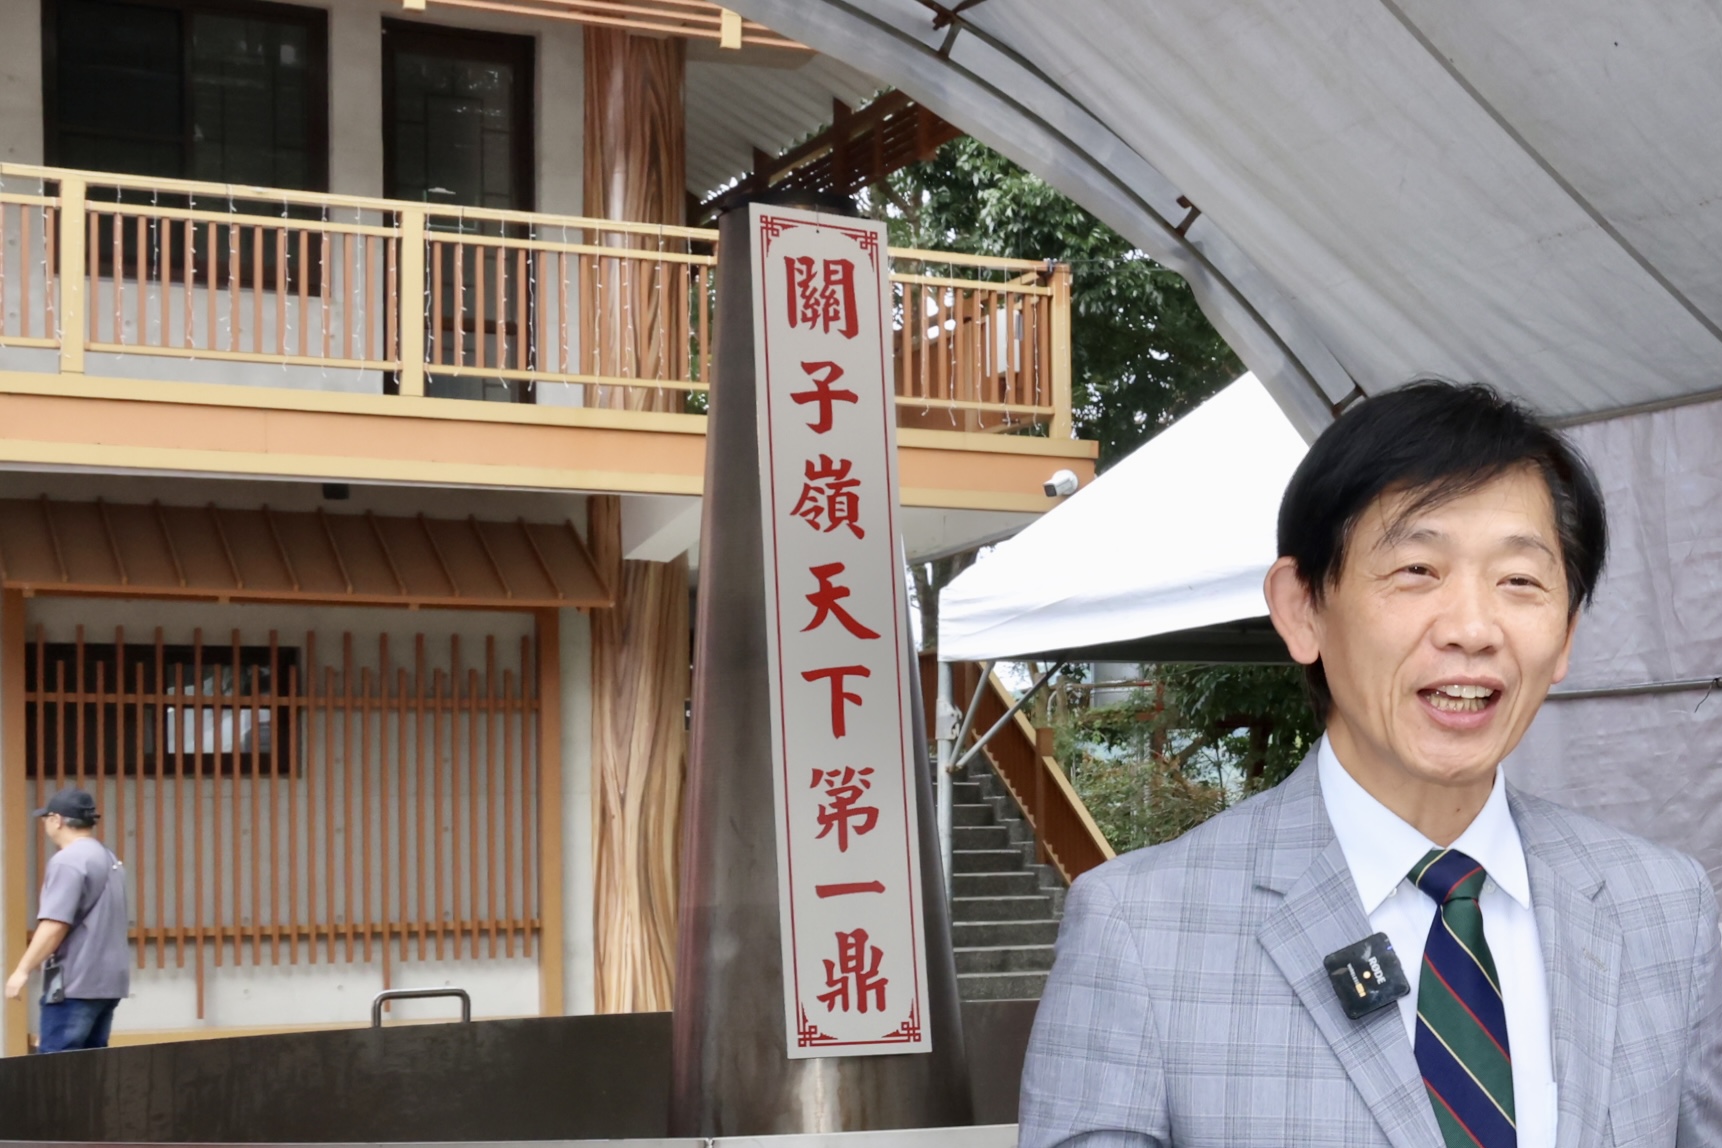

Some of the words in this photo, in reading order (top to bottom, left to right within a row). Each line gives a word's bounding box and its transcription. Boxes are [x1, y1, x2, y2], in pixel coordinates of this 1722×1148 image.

[784, 256, 888, 1014] 關子嶺天下第一鼎
